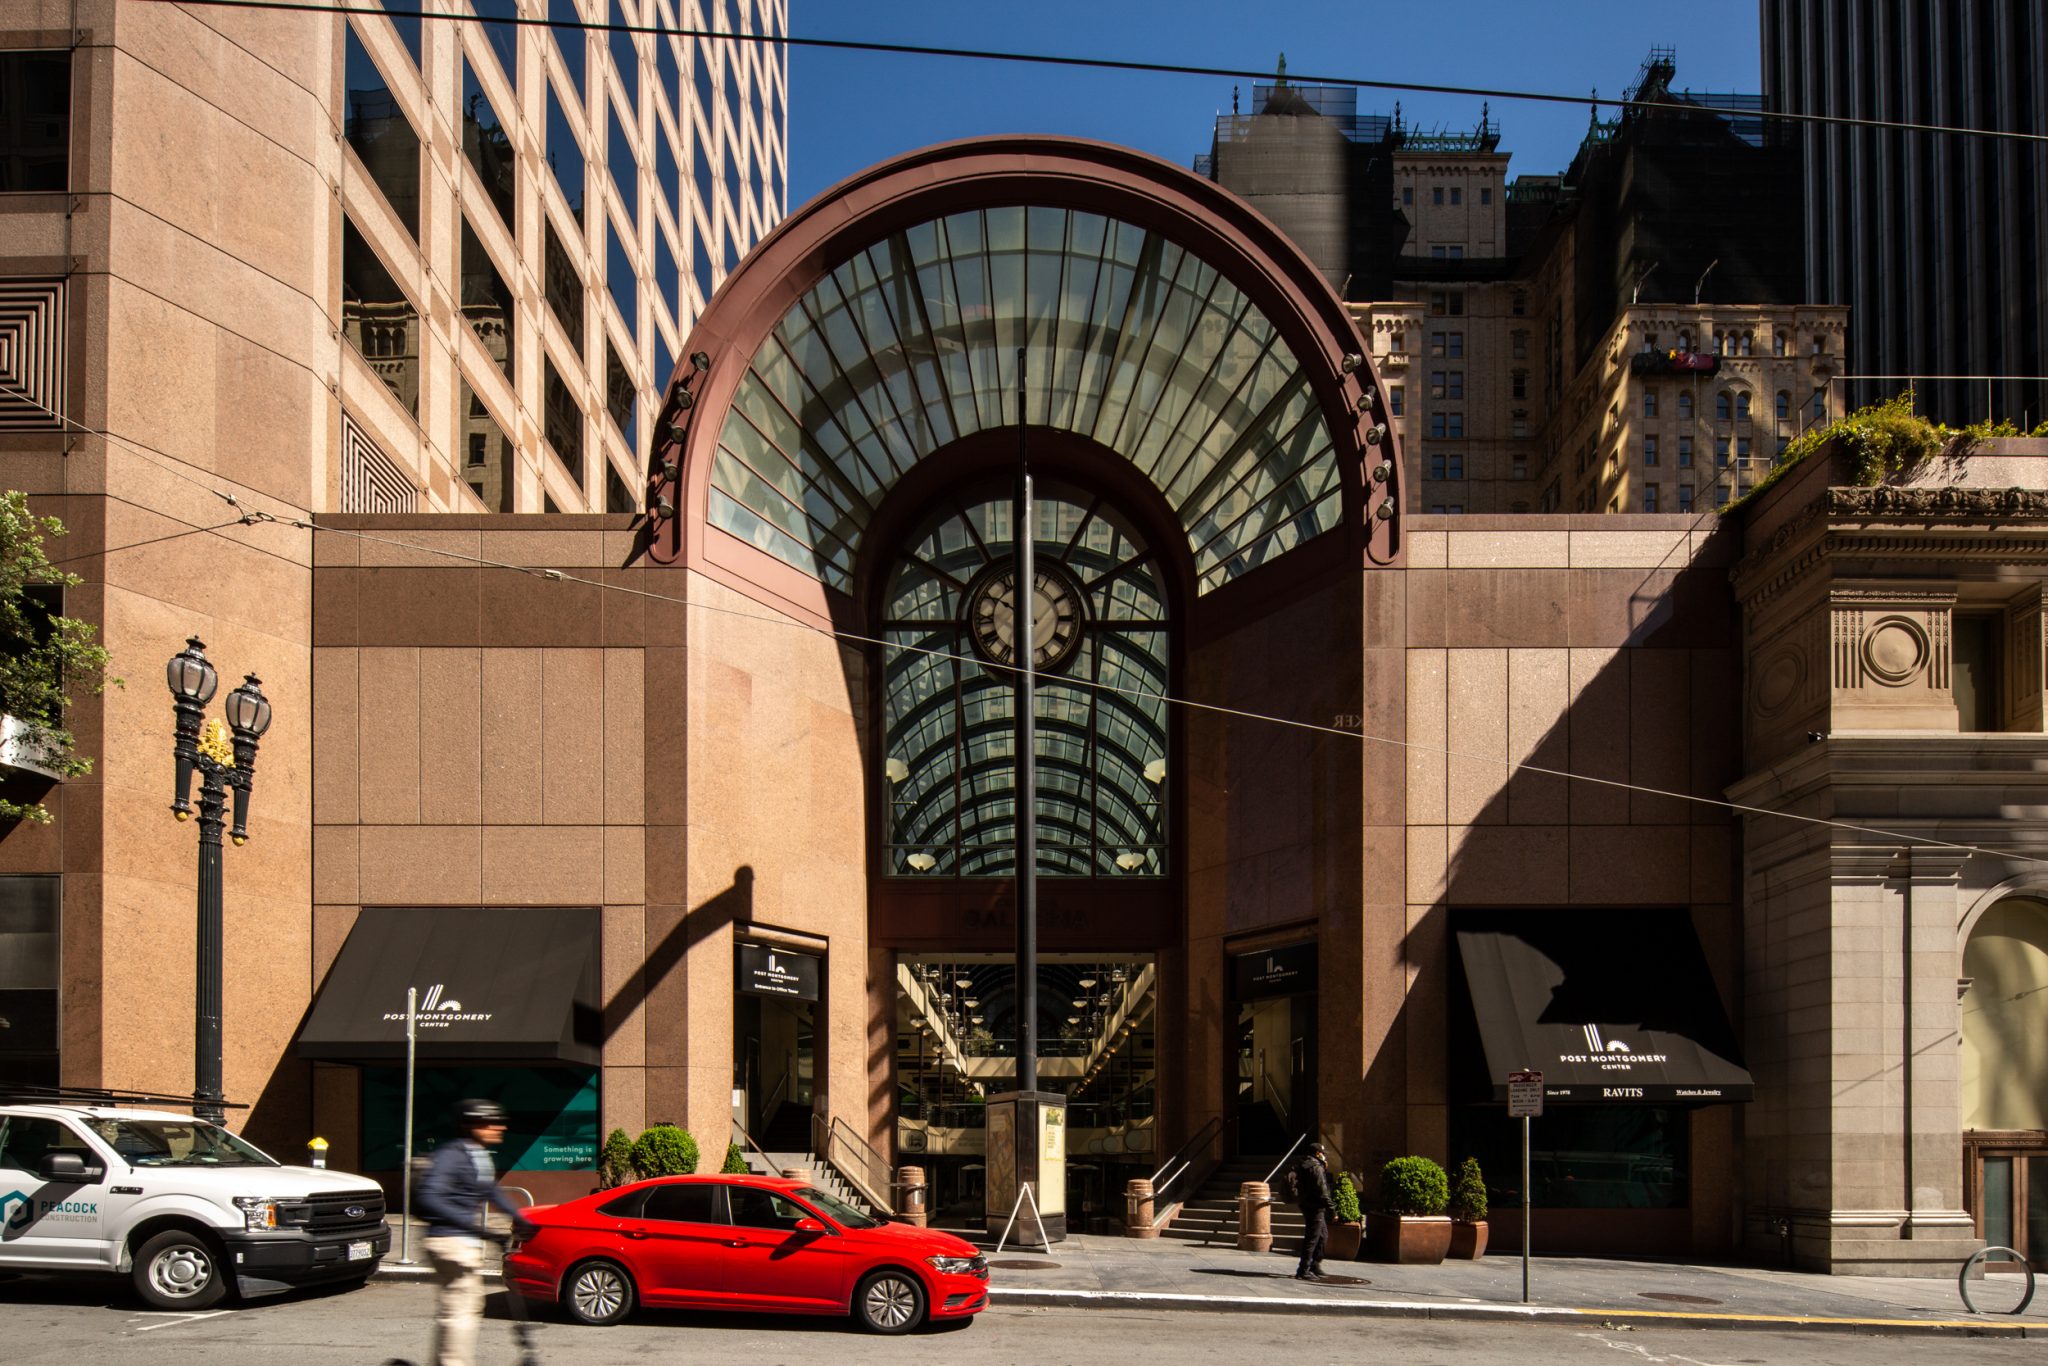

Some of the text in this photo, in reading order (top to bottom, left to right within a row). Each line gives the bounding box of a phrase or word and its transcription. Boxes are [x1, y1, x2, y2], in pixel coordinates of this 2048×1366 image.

[1559, 1054, 1667, 1063] POST MONTGOMERY
[1601, 1063, 1632, 1071] CENTER
[1603, 1087, 1644, 1098] RAVITS
[544, 1146, 584, 1154] Something
[543, 1155, 574, 1164] growing
[40, 1200, 98, 1214] PEACOCK
